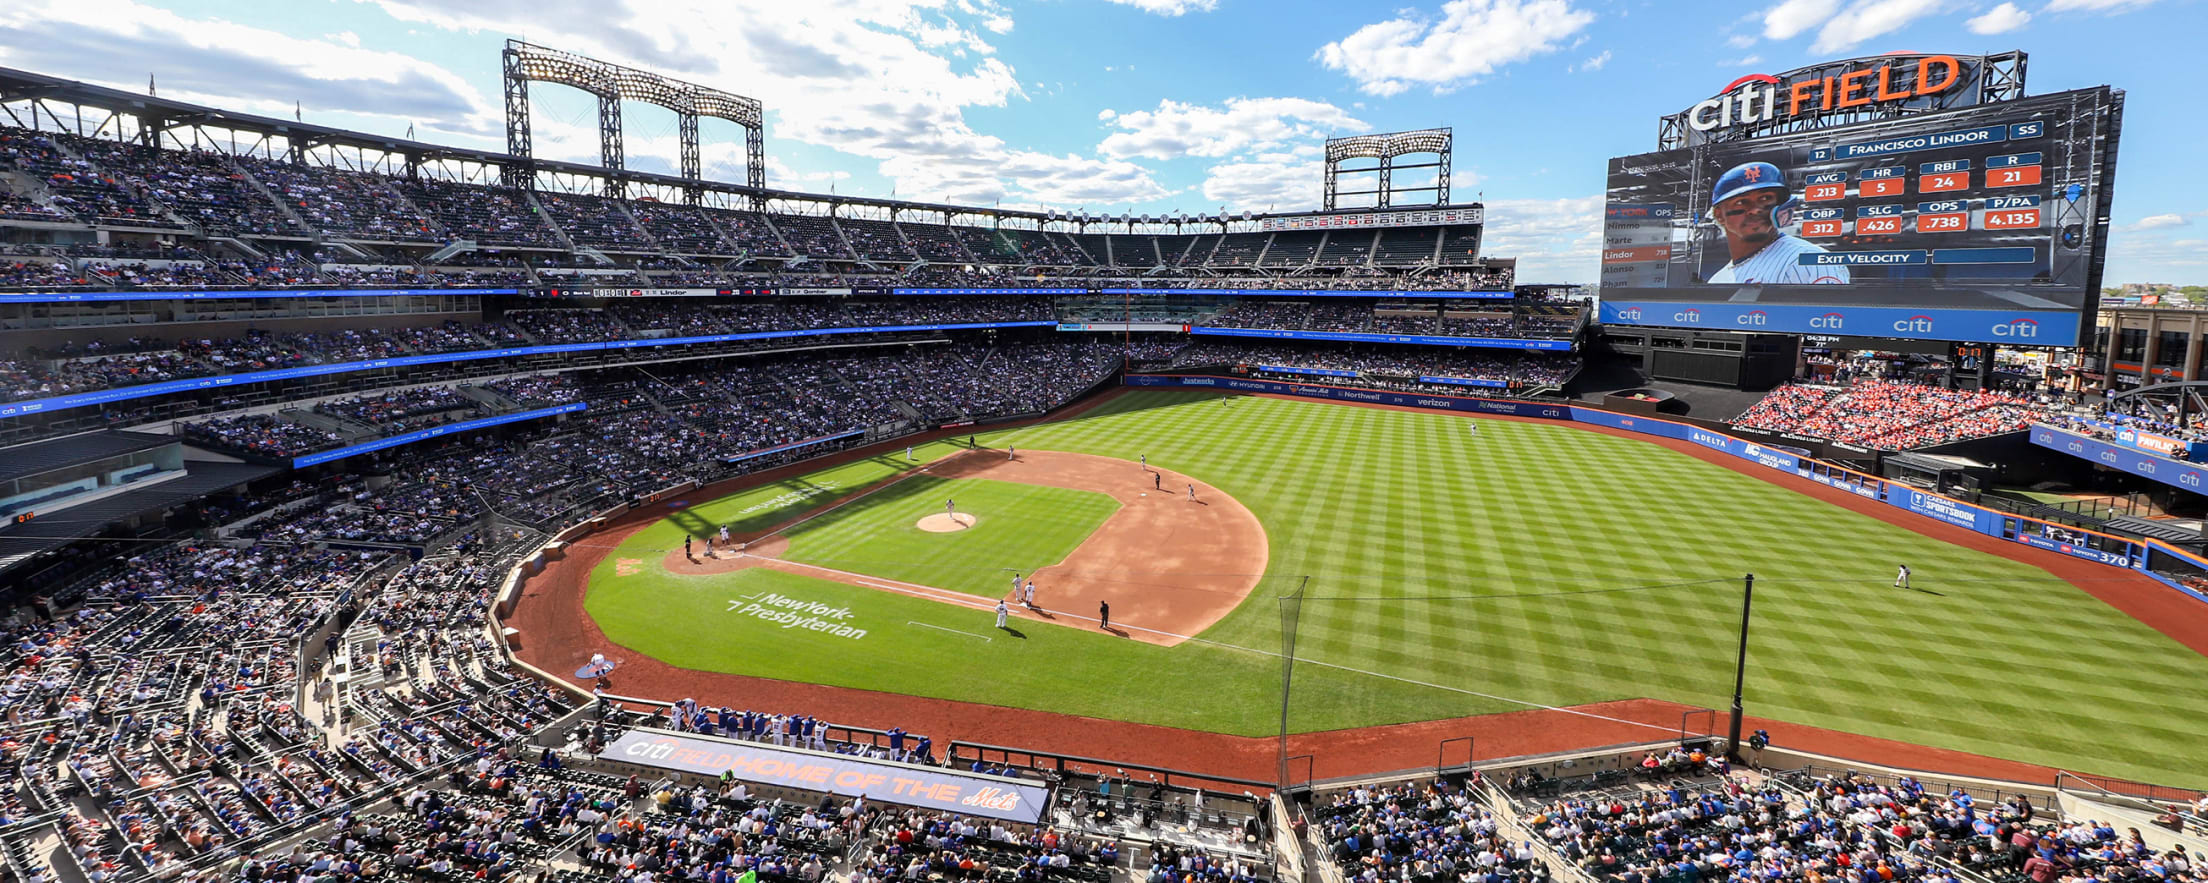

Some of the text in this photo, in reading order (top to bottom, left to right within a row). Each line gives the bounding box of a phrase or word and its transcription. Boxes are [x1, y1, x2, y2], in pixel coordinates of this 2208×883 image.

[1688, 55, 1960, 131] citi FIELD
[2018, 124, 2037, 135] SS
[1814, 130, 1990, 159] 12 FRANCISCO LINDOR
[2008, 155, 2018, 165] R
[1934, 161, 1957, 172] RBI
[1814, 173, 1839, 183] AVG
[1873, 168, 1892, 178] HR
[2003, 171, 2021, 182] 21
[1876, 183, 1886, 193] 5
[1934, 177, 1954, 188] 24
[1813, 187, 1837, 198] .213
[1929, 202, 1959, 212] OPS
[1994, 197, 2032, 208] P/PA
[1655, 209, 1672, 217] OPS
[1811, 209, 1836, 219] OBP
[1868, 205, 1892, 216] SLG
[1925, 217, 1960, 229] .738
[1989, 212, 2036, 225] 4.135
[1607, 221, 1641, 230] Nimmo
[1809, 223, 1834, 234] .312
[1862, 220, 1895, 231] .426
[1606, 236, 1633, 245] Marte
[1604, 251, 1634, 260] Lindor
[1817, 253, 1910, 264] EXIT VELOCITY
[1603, 265, 1635, 274] Alonso
[1618, 308, 1641, 320] citi
[1673, 309, 1700, 323] citi
[1737, 311, 1767, 326] citi
[1809, 313, 1845, 329] citi
[1893, 316, 1933, 333] citi
[1991, 320, 2038, 338] citi
[1182, 377, 1215, 386] Justworks
[1344, 391, 1380, 401] Northwell
[1417, 398, 1450, 408] verizon
[1486, 402, 1517, 411] National
[2, 407, 16, 415] citi
[1542, 408, 1560, 417] citi
[1700, 435, 1727, 448] DELTA
[2039, 433, 2053, 444] citi
[2119, 430, 2135, 443] citi
[2068, 441, 2083, 453] citi
[2100, 451, 2117, 463] citi
[1759, 458, 1779, 469] GROUP
[2137, 461, 2156, 475] citi
[1813, 474, 1831, 485] GOYA
[2179, 473, 2200, 487] citi
[1833, 480, 1852, 491] GOYA
[1855, 487, 1875, 498] GOYA
[1926, 494, 1957, 508] CAESARS
[1925, 501, 1976, 522] SPORTSBOOK
[2029, 538, 2055, 548] TOYOTA
[2071, 548, 2099, 559] TOYOTA
[2099, 551, 2129, 567] 370
[738, 602, 868, 640] Presbyterian
[626, 740, 1021, 812] citi FIELD HOME OF THE Mets
